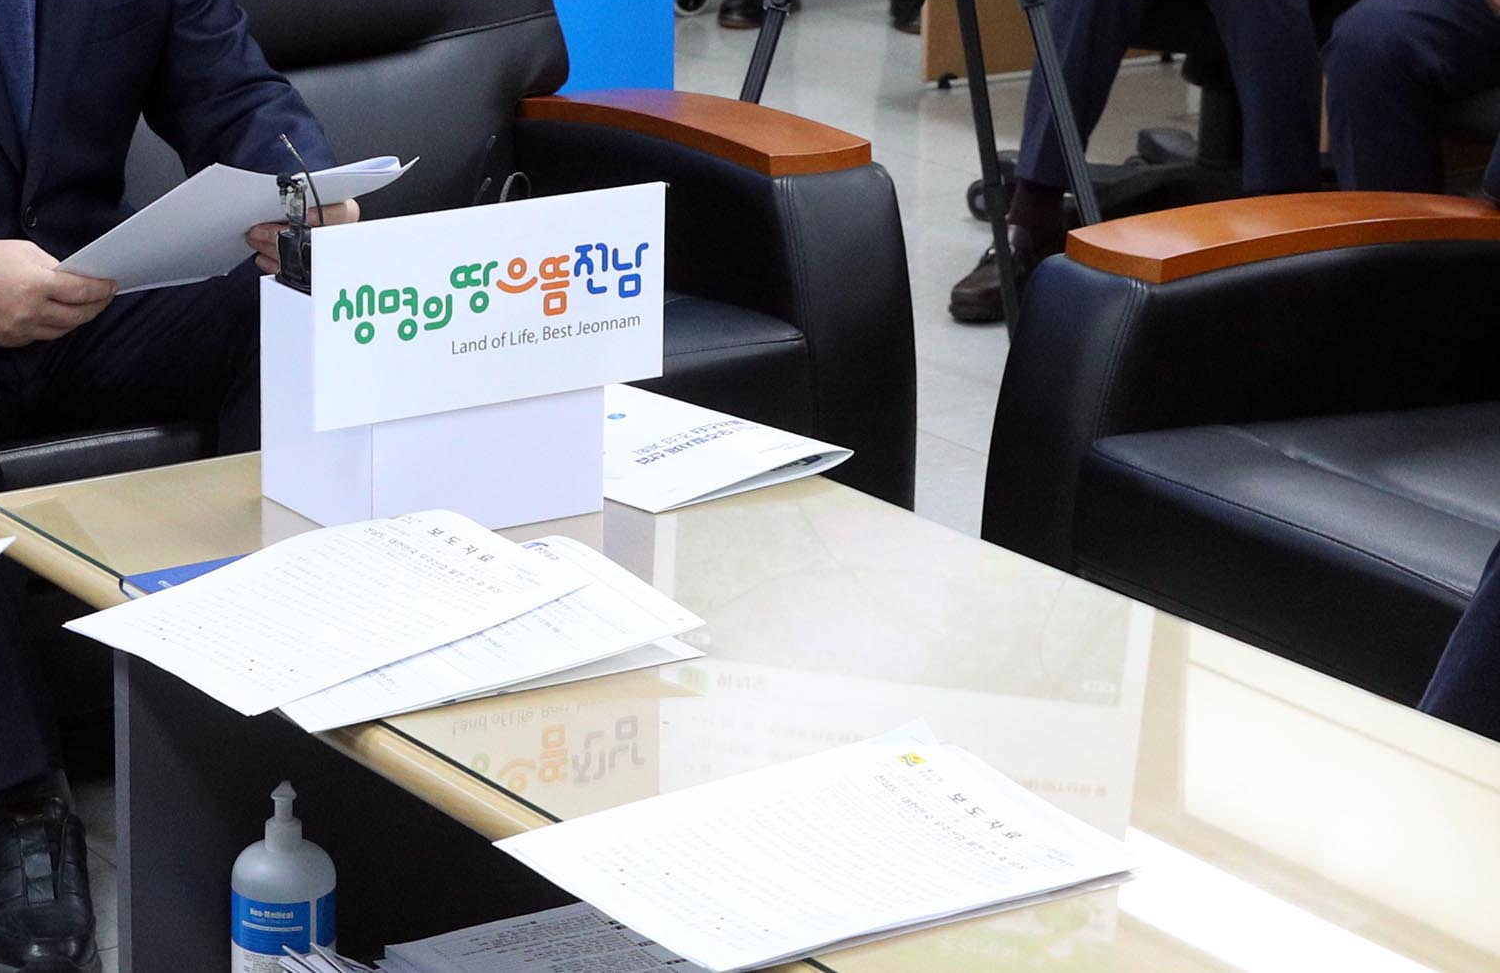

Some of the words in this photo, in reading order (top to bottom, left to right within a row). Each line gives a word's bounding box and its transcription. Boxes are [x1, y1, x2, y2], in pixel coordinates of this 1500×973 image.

[451, 334, 488, 356] Land
[491, 332, 507, 350] of
[510, 328, 540, 347] Life,
[543, 324, 573, 343] Best
[576, 314, 641, 339] Jeonnam
